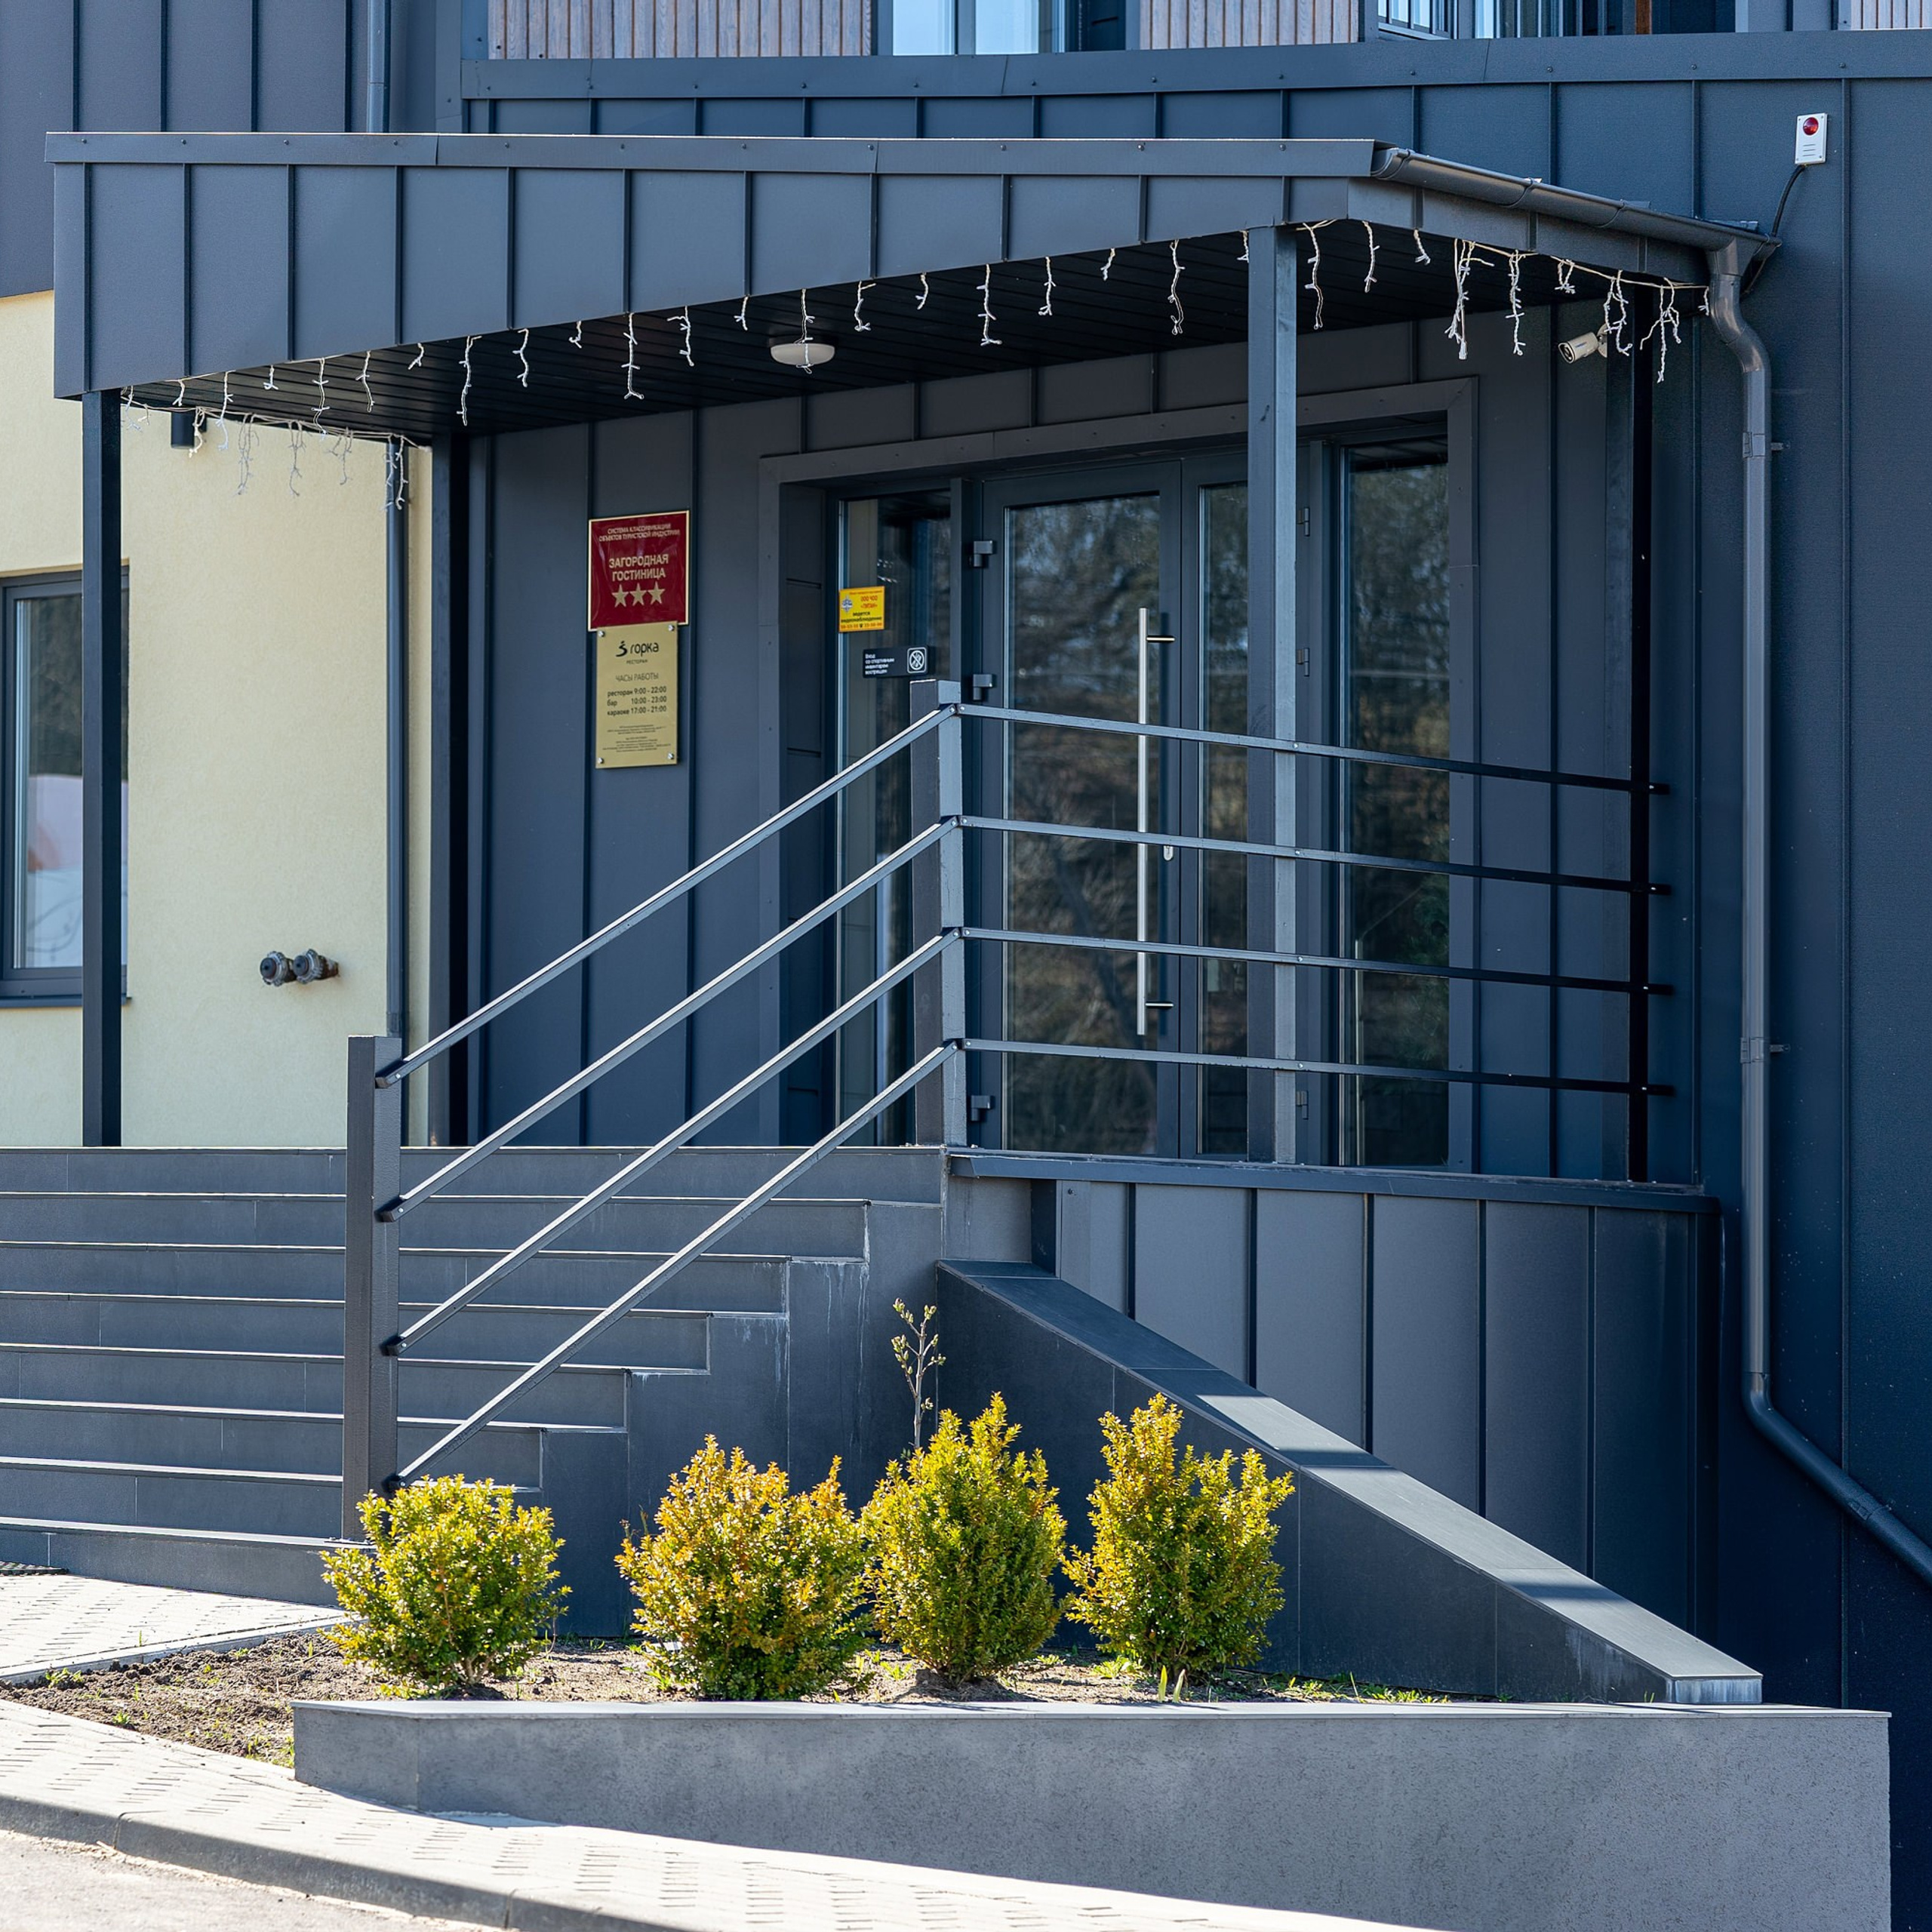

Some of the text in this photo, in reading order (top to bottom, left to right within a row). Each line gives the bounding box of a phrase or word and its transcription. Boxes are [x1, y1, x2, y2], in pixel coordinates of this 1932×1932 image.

[629, 524, 671, 533] КЛАССИФИКАЦИИ
[651, 529, 681, 537] ИНДУСТРИИ
[608, 553, 669, 569] ЗАГОРОДНАЯ
[612, 568, 666, 582] ГОСТИНИЦА
[629, 642, 659, 657] горка
[615, 672, 659, 682] ЧАСЫ РАБОТЫ
[651, 685, 667, 694] 22:00
[607, 699, 617, 707] бар
[631, 697, 647, 705] 10:00
[651, 695, 667, 703] 23:00
[651, 705, 667, 713] 21:00
